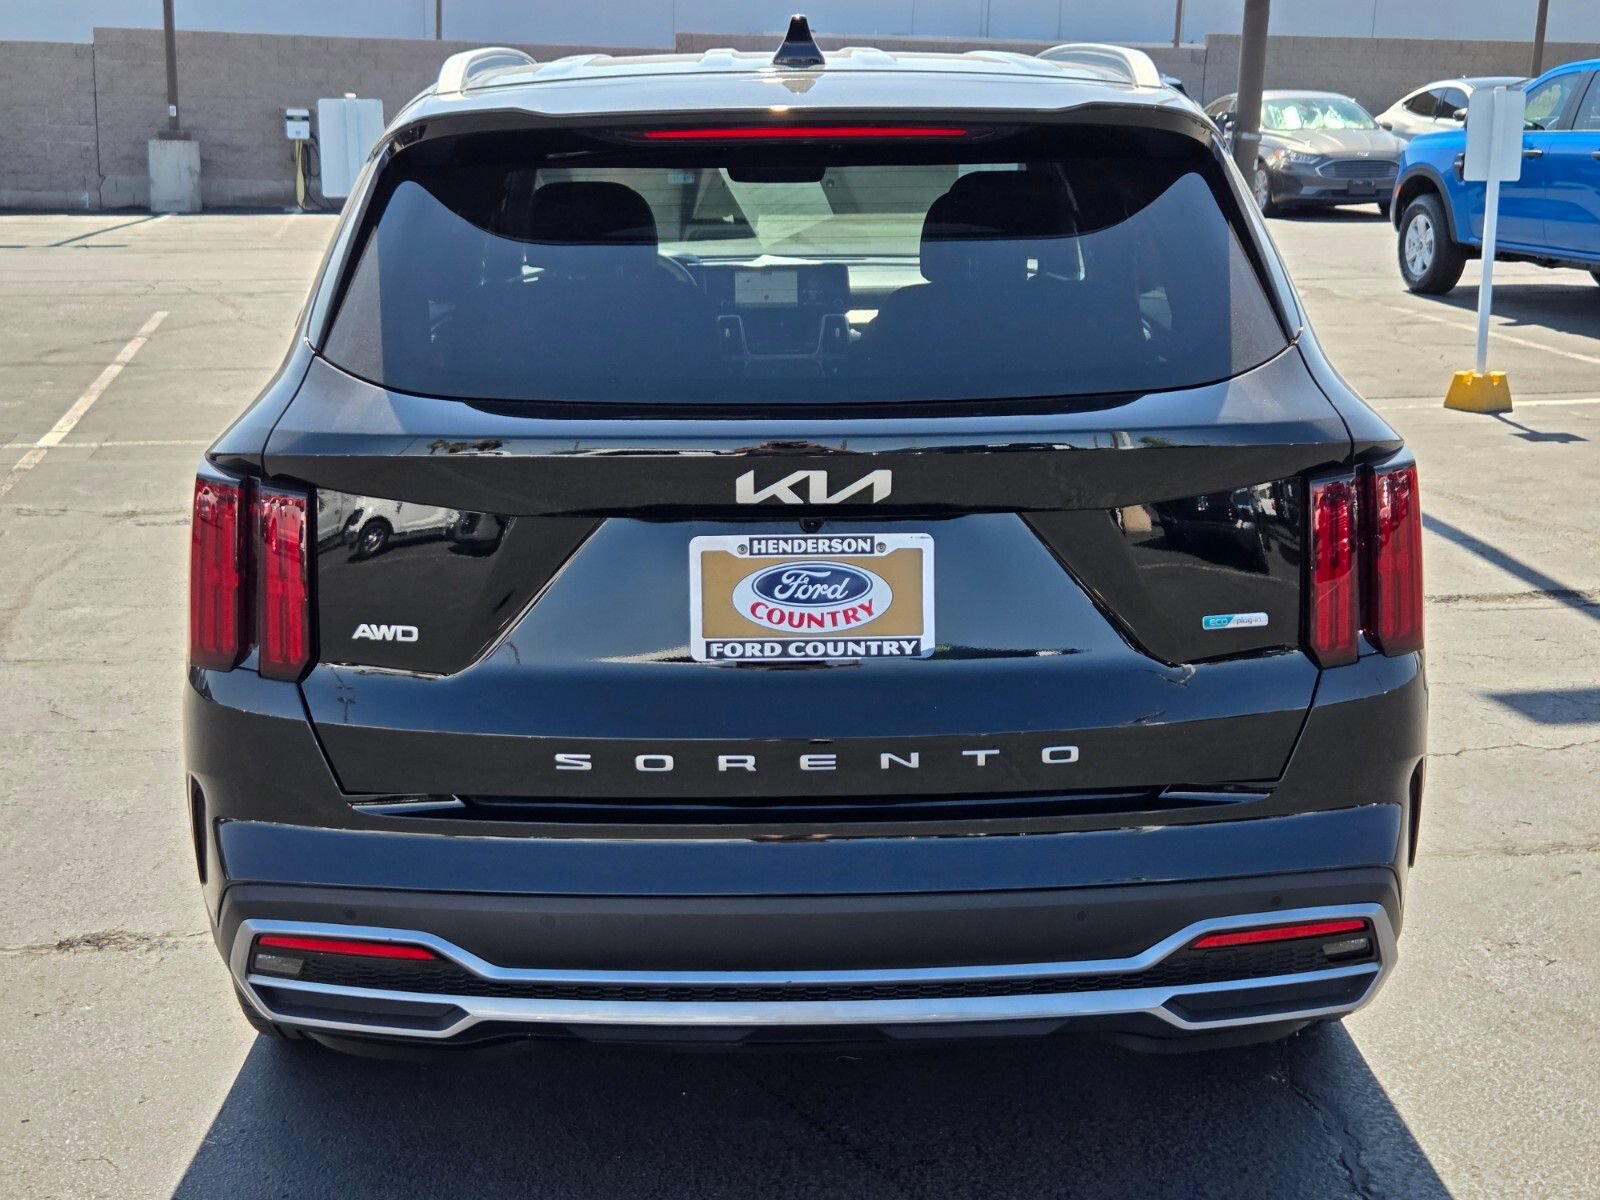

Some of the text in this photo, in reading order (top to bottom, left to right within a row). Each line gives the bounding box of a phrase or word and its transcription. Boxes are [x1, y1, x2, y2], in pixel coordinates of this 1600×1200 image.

[736, 470, 892, 504] KIA
[752, 538, 871, 554] HENDERSON
[774, 569, 849, 600] Ford
[750, 598, 874, 629] COUNTRY
[352, 624, 418, 641] AWD
[710, 640, 918, 657] FORD COUNTRY
[555, 745, 1079, 773] SORENTO
